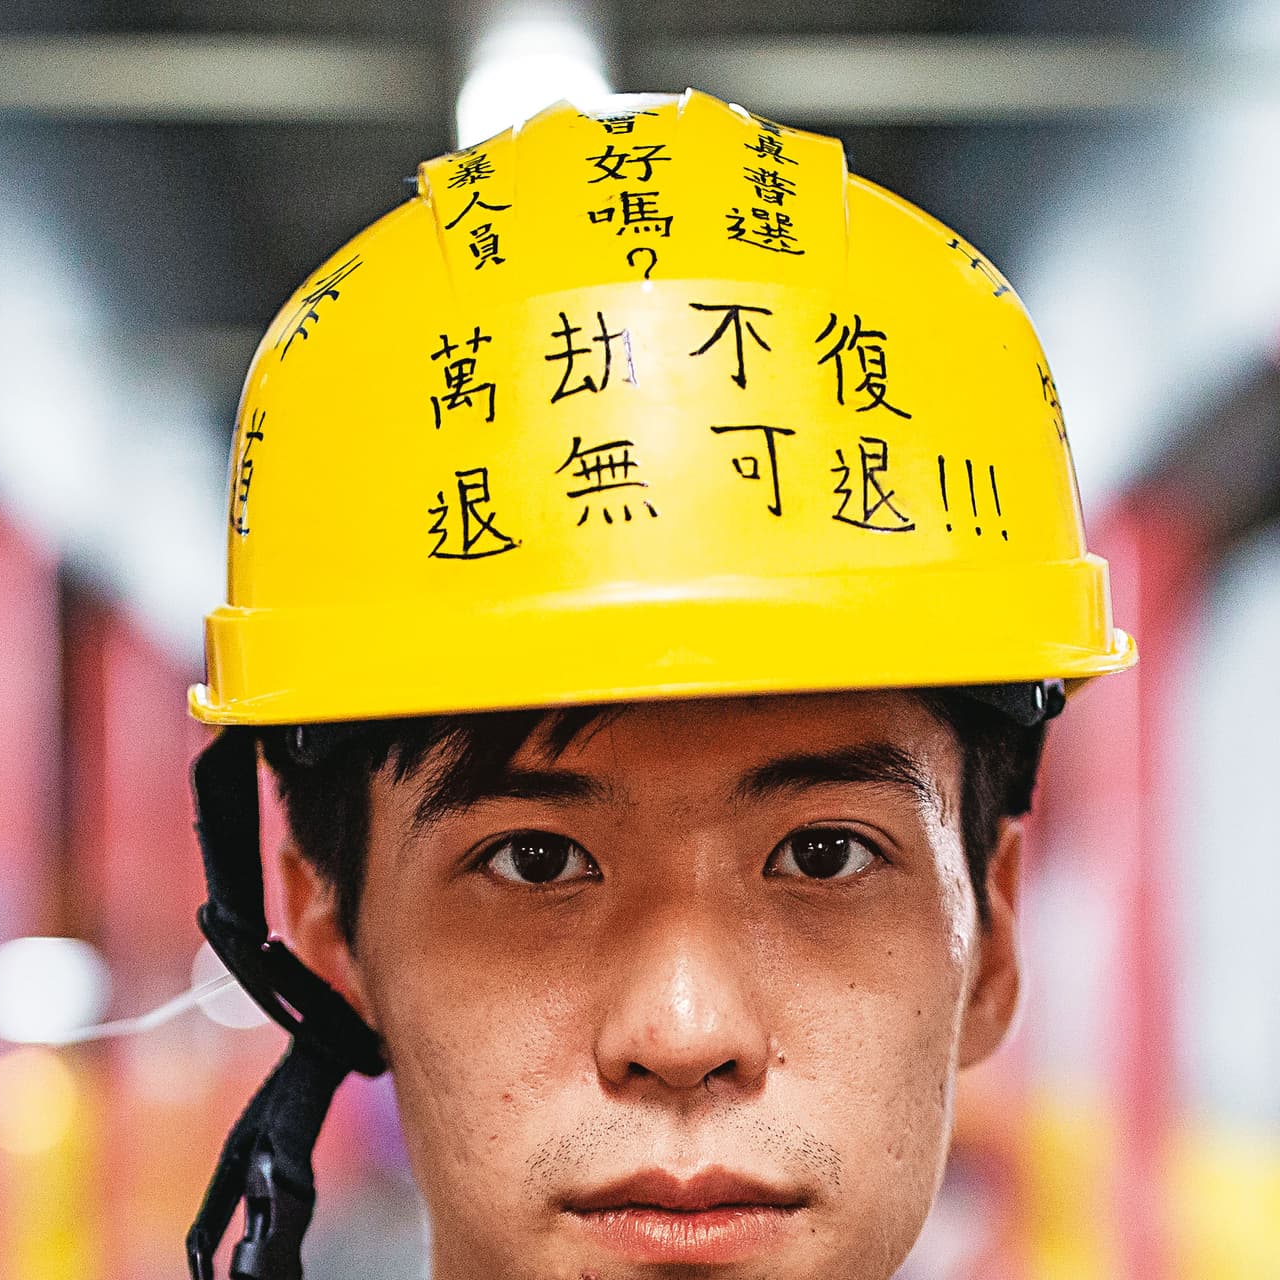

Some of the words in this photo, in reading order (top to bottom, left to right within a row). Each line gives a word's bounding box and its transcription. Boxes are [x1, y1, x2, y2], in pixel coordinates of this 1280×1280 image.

[445, 150, 512, 271] 暴人員
[725, 116, 806, 256] 真普選
[430, 302, 913, 431] 萬劫不復
